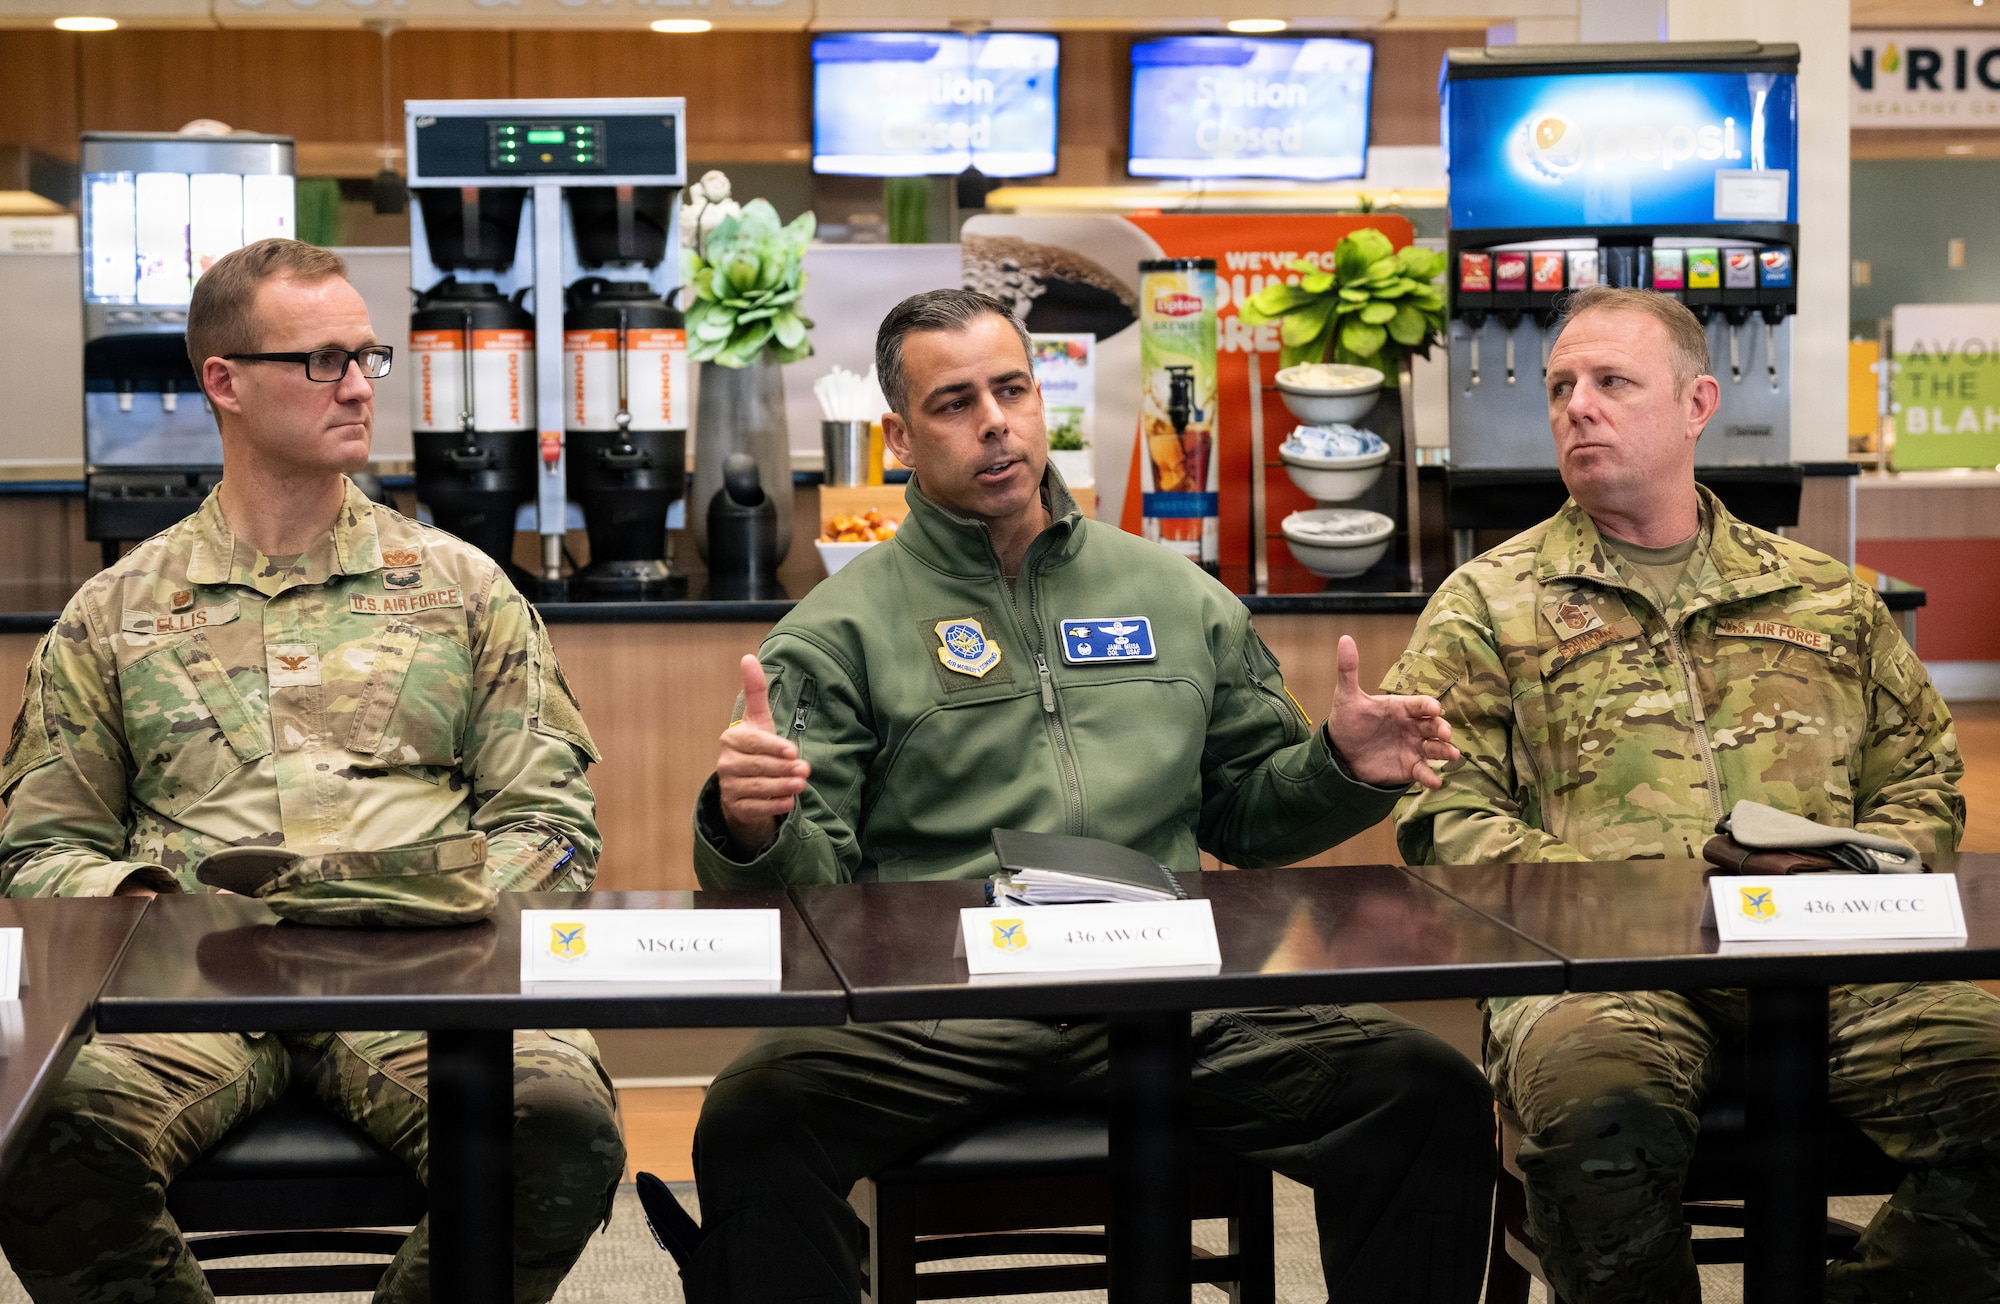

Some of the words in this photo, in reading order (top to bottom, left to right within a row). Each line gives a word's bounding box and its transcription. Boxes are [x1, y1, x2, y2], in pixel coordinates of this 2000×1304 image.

[1225, 251, 1298, 271] WE'VE
[1303, 251, 1336, 271] GO
[1157, 299, 1201, 314] Lipton
[1907, 371, 1977, 400] THE
[354, 596, 381, 612] U.S.
[383, 597, 409, 612] AIR
[409, 589, 458, 610] FORCE
[156, 609, 208, 633] ELLIS
[1557, 625, 1620, 660] EDWARDS
[1724, 620, 1750, 634] U.S.
[1752, 622, 1776, 636] AIR
[1779, 625, 1821, 647] FORCE
[946, 659, 957, 668] AIR
[1804, 899, 1836, 914] 436
[1840, 898, 1926, 914] AW/CCC
[635, 937, 724, 953] MSG/CC
[1064, 929, 1096, 944] 436
[1102, 926, 1170, 943] AW/CC
